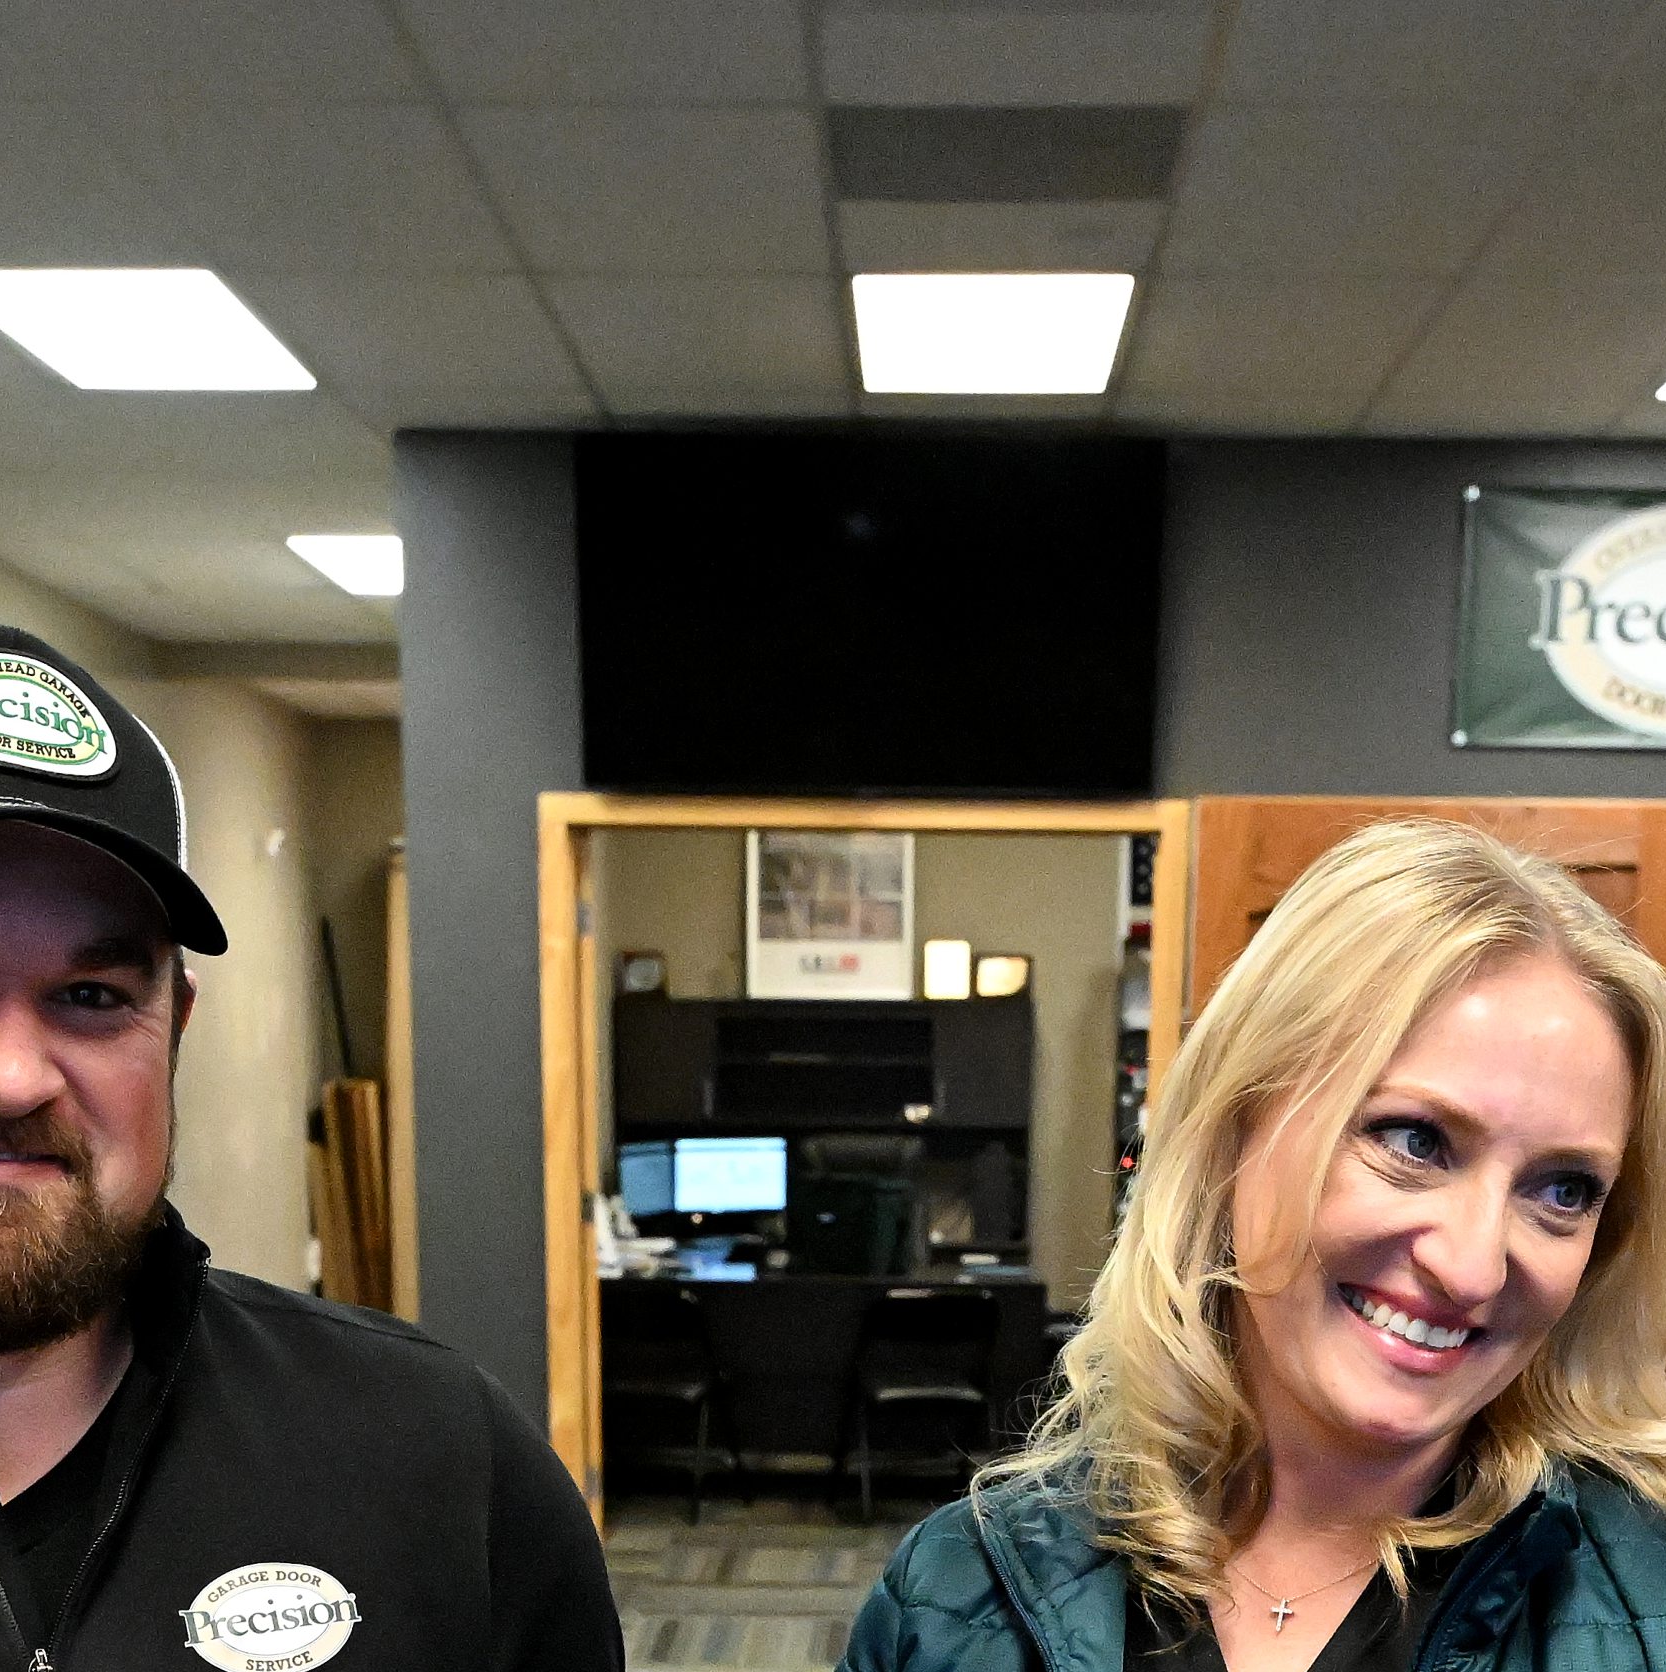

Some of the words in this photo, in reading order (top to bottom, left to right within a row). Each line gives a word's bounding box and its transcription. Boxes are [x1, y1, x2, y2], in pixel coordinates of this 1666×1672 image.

[39, 671, 91, 718] GARAGE
[16, 739, 76, 759] SERVICE
[207, 1570, 269, 1603] GARAGE
[275, 1570, 322, 1588] DOOR
[181, 1594, 359, 1645] Precision
[245, 1651, 314, 1672] SERVICE
